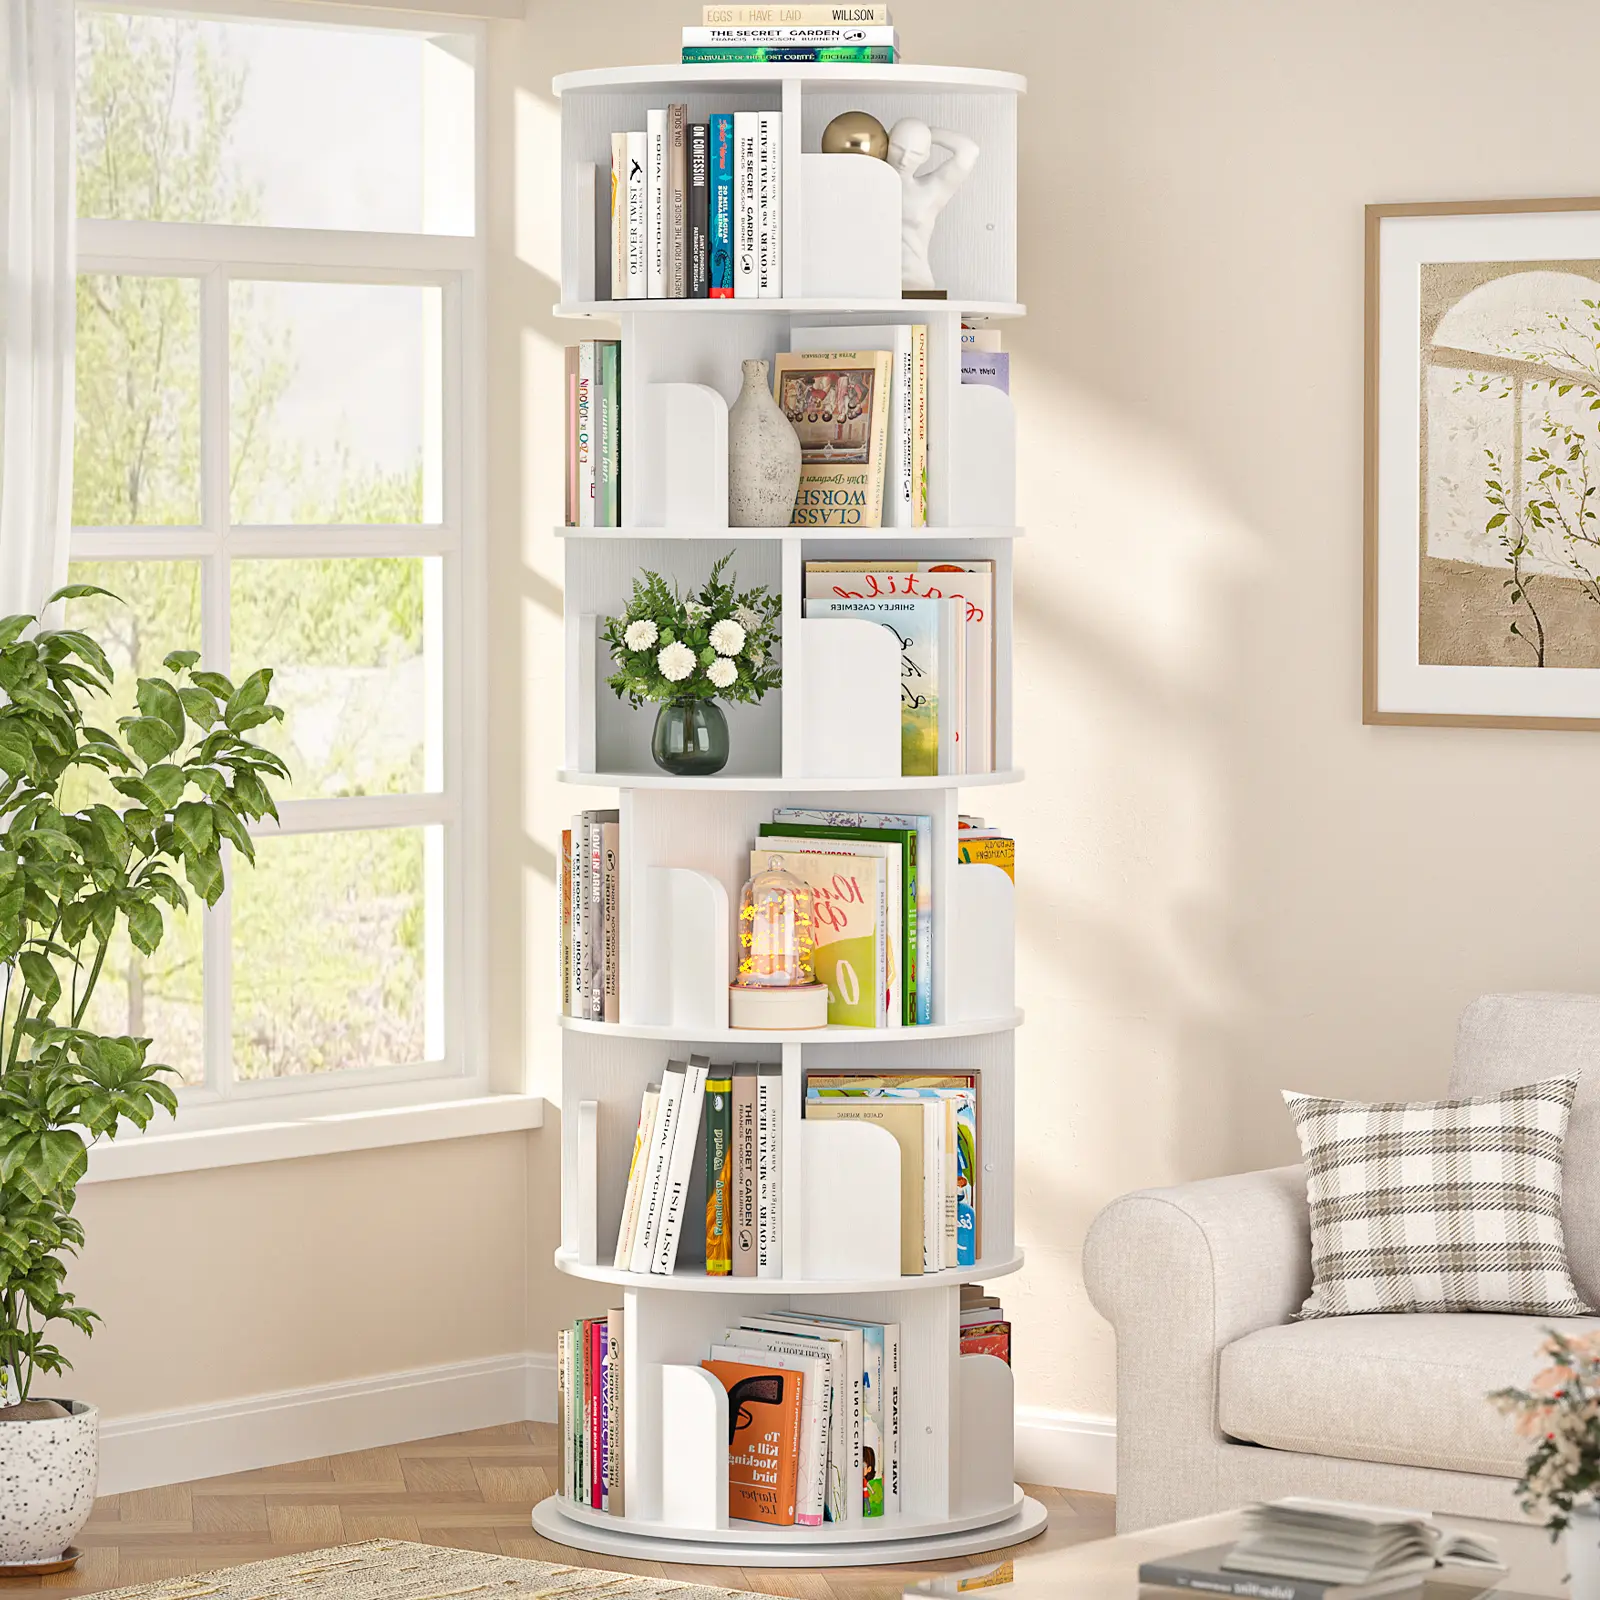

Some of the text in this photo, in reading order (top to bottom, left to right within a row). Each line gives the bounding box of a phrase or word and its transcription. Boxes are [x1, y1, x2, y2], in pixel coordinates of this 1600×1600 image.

[707, 12, 732, 23] EGGS
[749, 11, 772, 22] HAVE
[780, 11, 802, 22] LAID
[832, 9, 874, 21] WILLSON
[674, 106, 682, 147] GINA SOLEIL
[693, 126, 704, 187] ON CONFESSION
[674, 189, 682, 203] OUT
[723, 185, 728, 194] 20
[674, 204, 682, 226] INSIDE
[629, 187, 638, 274] OLIVER TWIST
[674, 227, 682, 240] THE
[674, 242, 682, 260] FROM
[806, 474, 868, 485] With Brethren
[592, 828, 600, 903] LOVE IN ARMS
[577, 914, 582, 926] OF
[592, 989, 600, 1012] EX3
[643, 1099, 673, 1248] SOCIAL PSYCHOLOGY
[714, 1129, 724, 1235] Fantasy World
[668, 1181, 682, 1224] FISH
